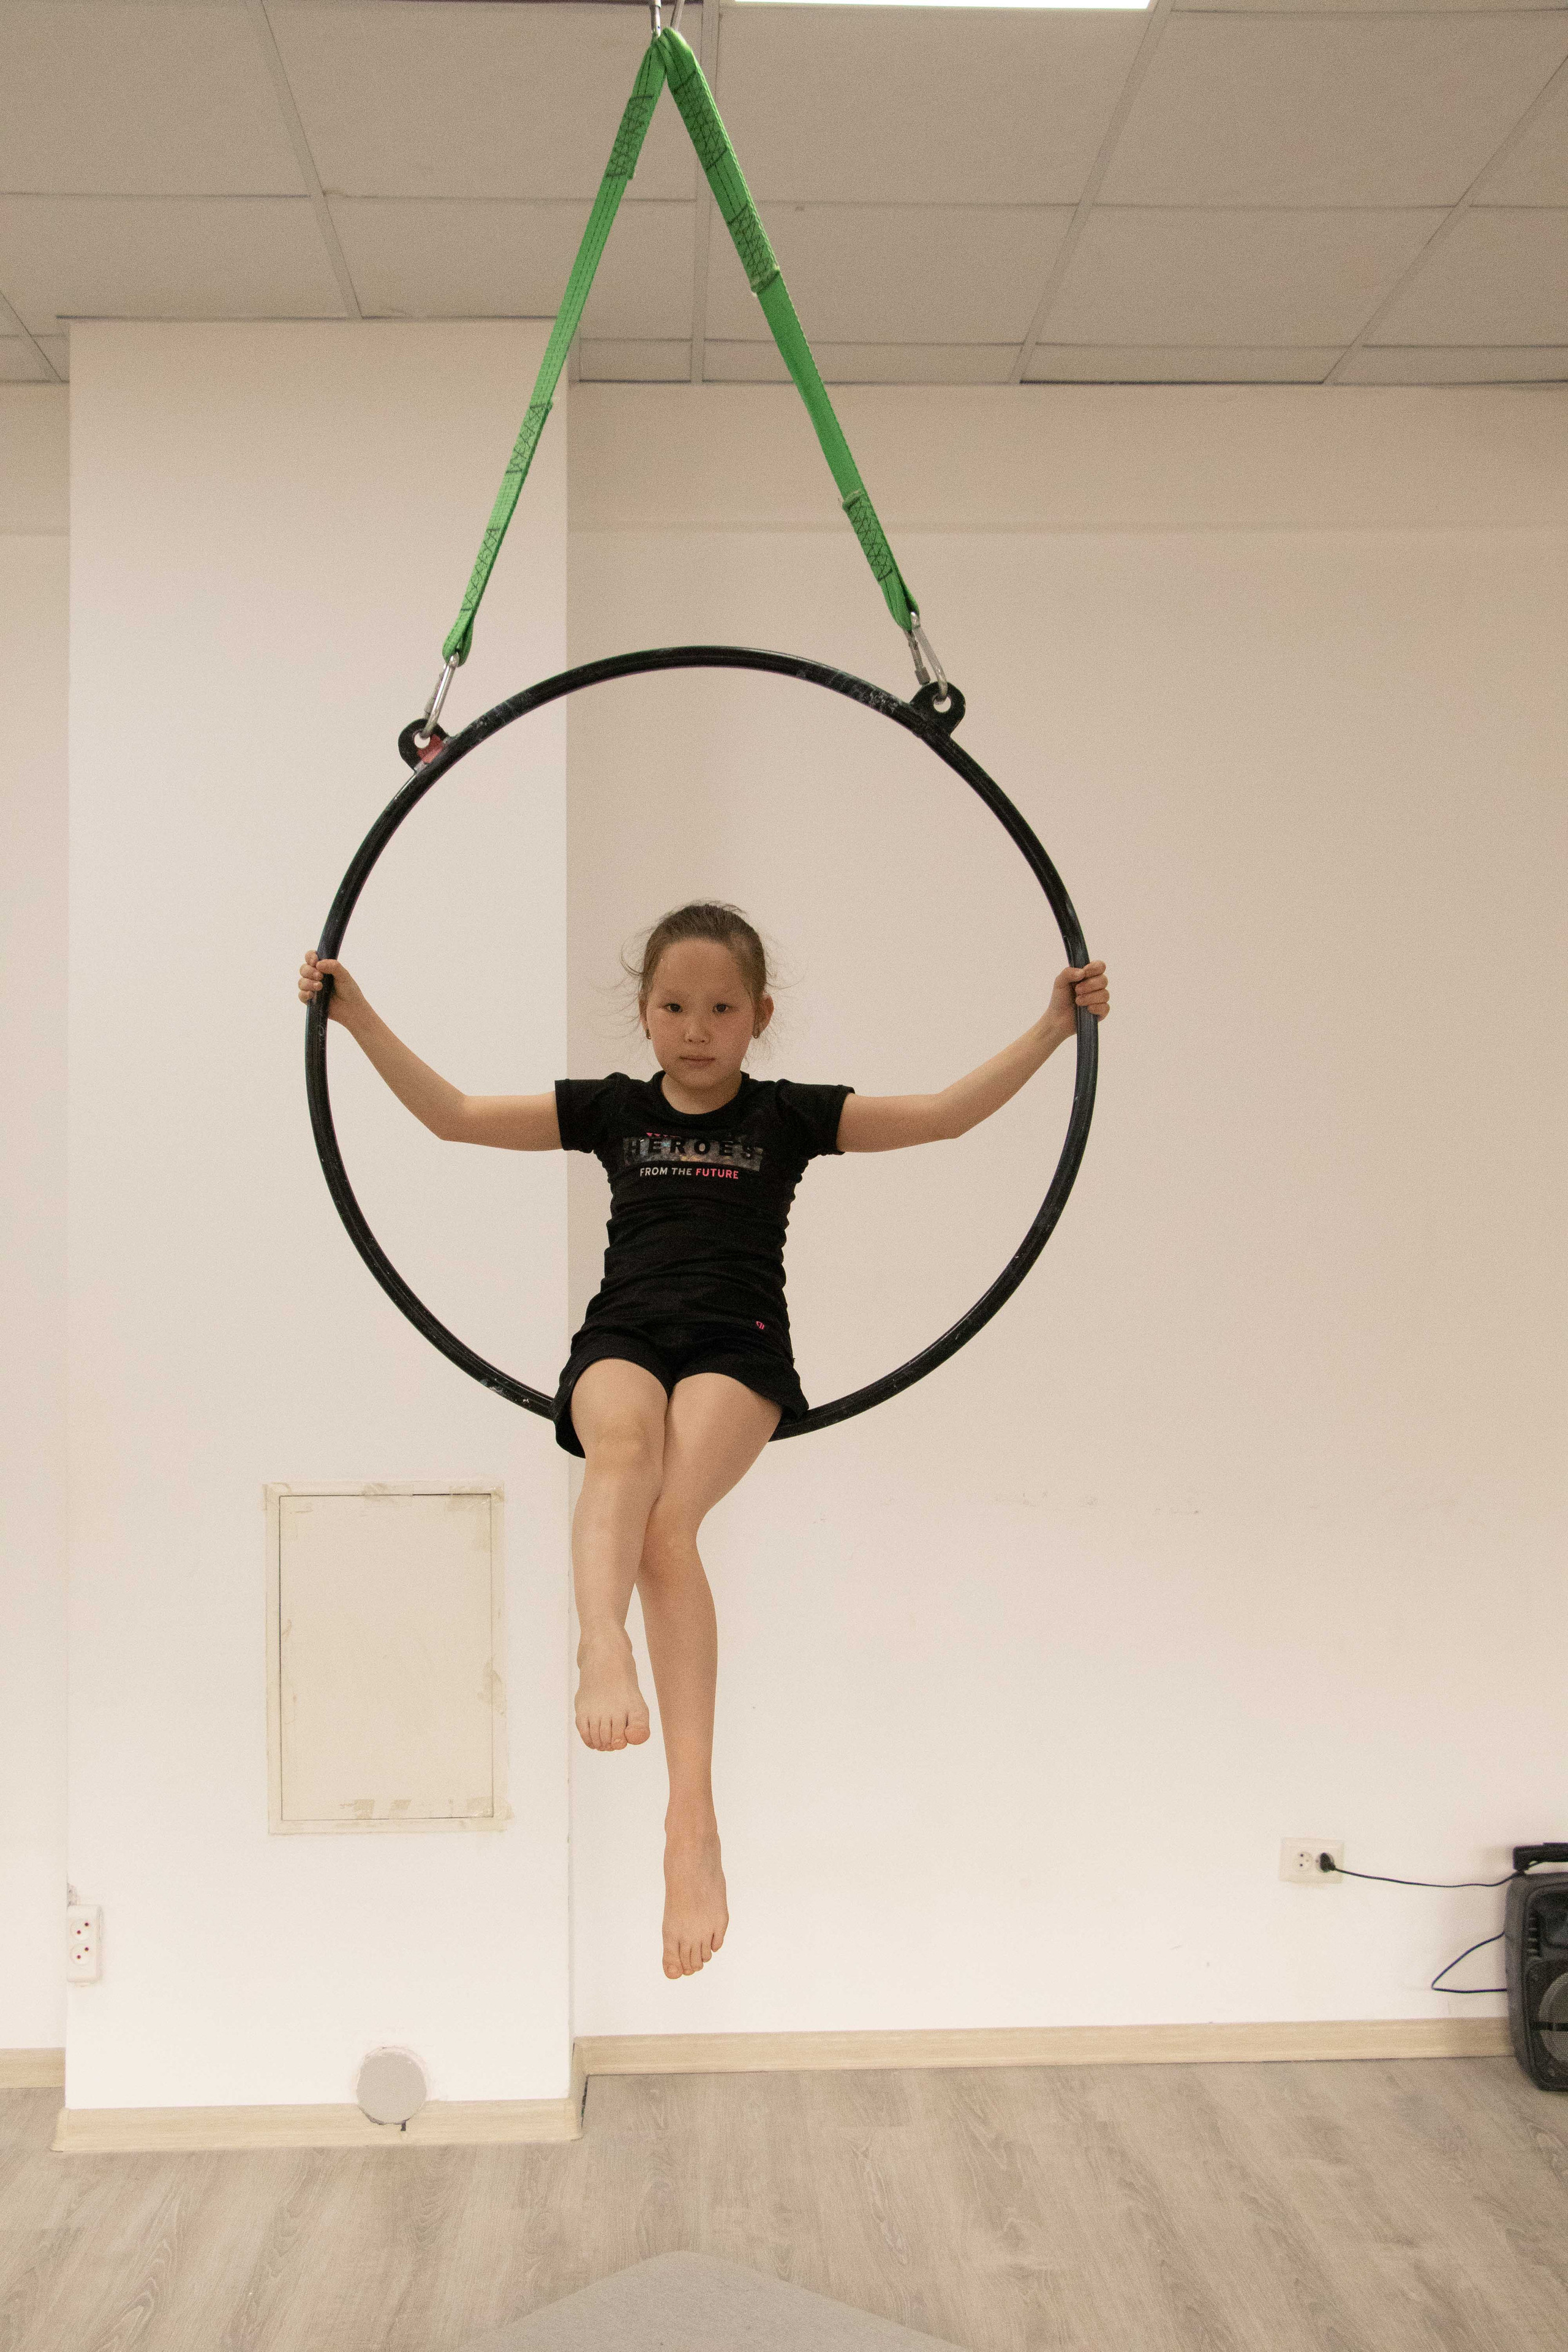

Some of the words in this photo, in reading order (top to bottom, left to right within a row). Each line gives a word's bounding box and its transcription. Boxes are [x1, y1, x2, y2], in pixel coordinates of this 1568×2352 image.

[627, 1137, 756, 1159] HEROES
[640, 1167, 668, 1177] FROM
[696, 1168, 739, 1179] FUTURE
